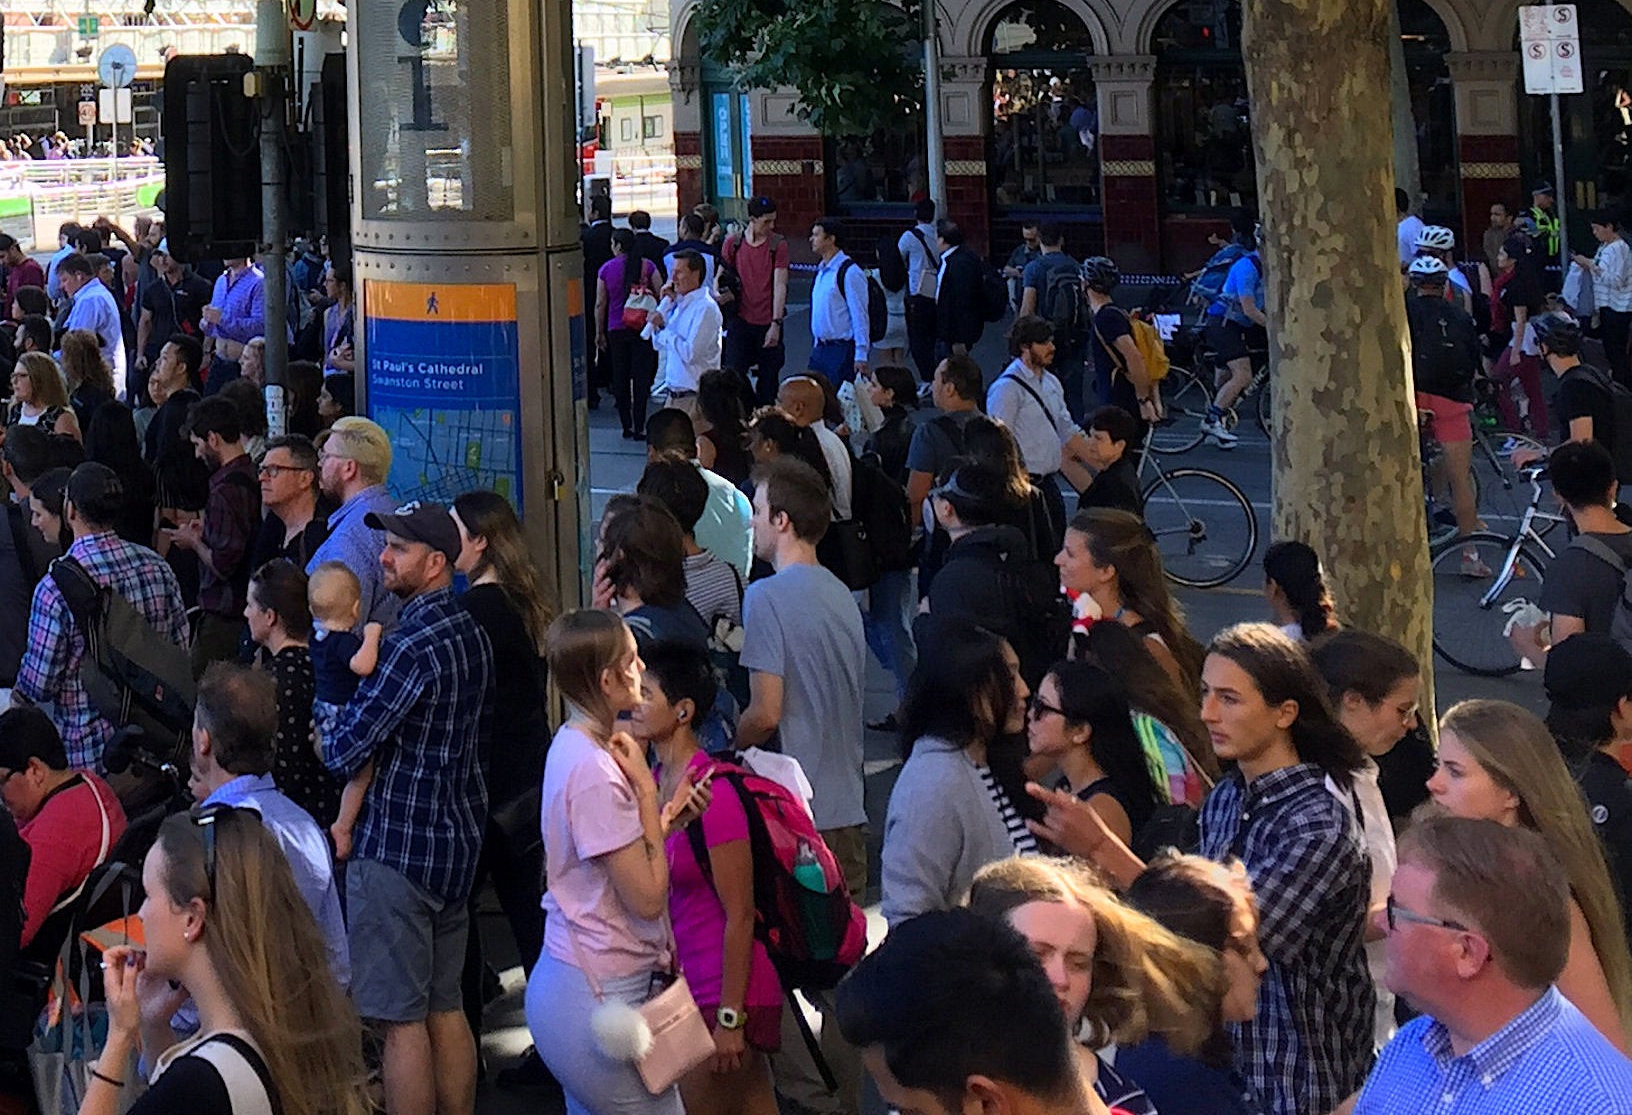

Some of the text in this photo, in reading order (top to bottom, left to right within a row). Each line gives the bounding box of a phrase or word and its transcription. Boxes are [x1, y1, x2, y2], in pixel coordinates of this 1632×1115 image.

[372, 358, 484, 375] St Paul's Cathedral
[372, 373, 464, 390] Swanston Street
